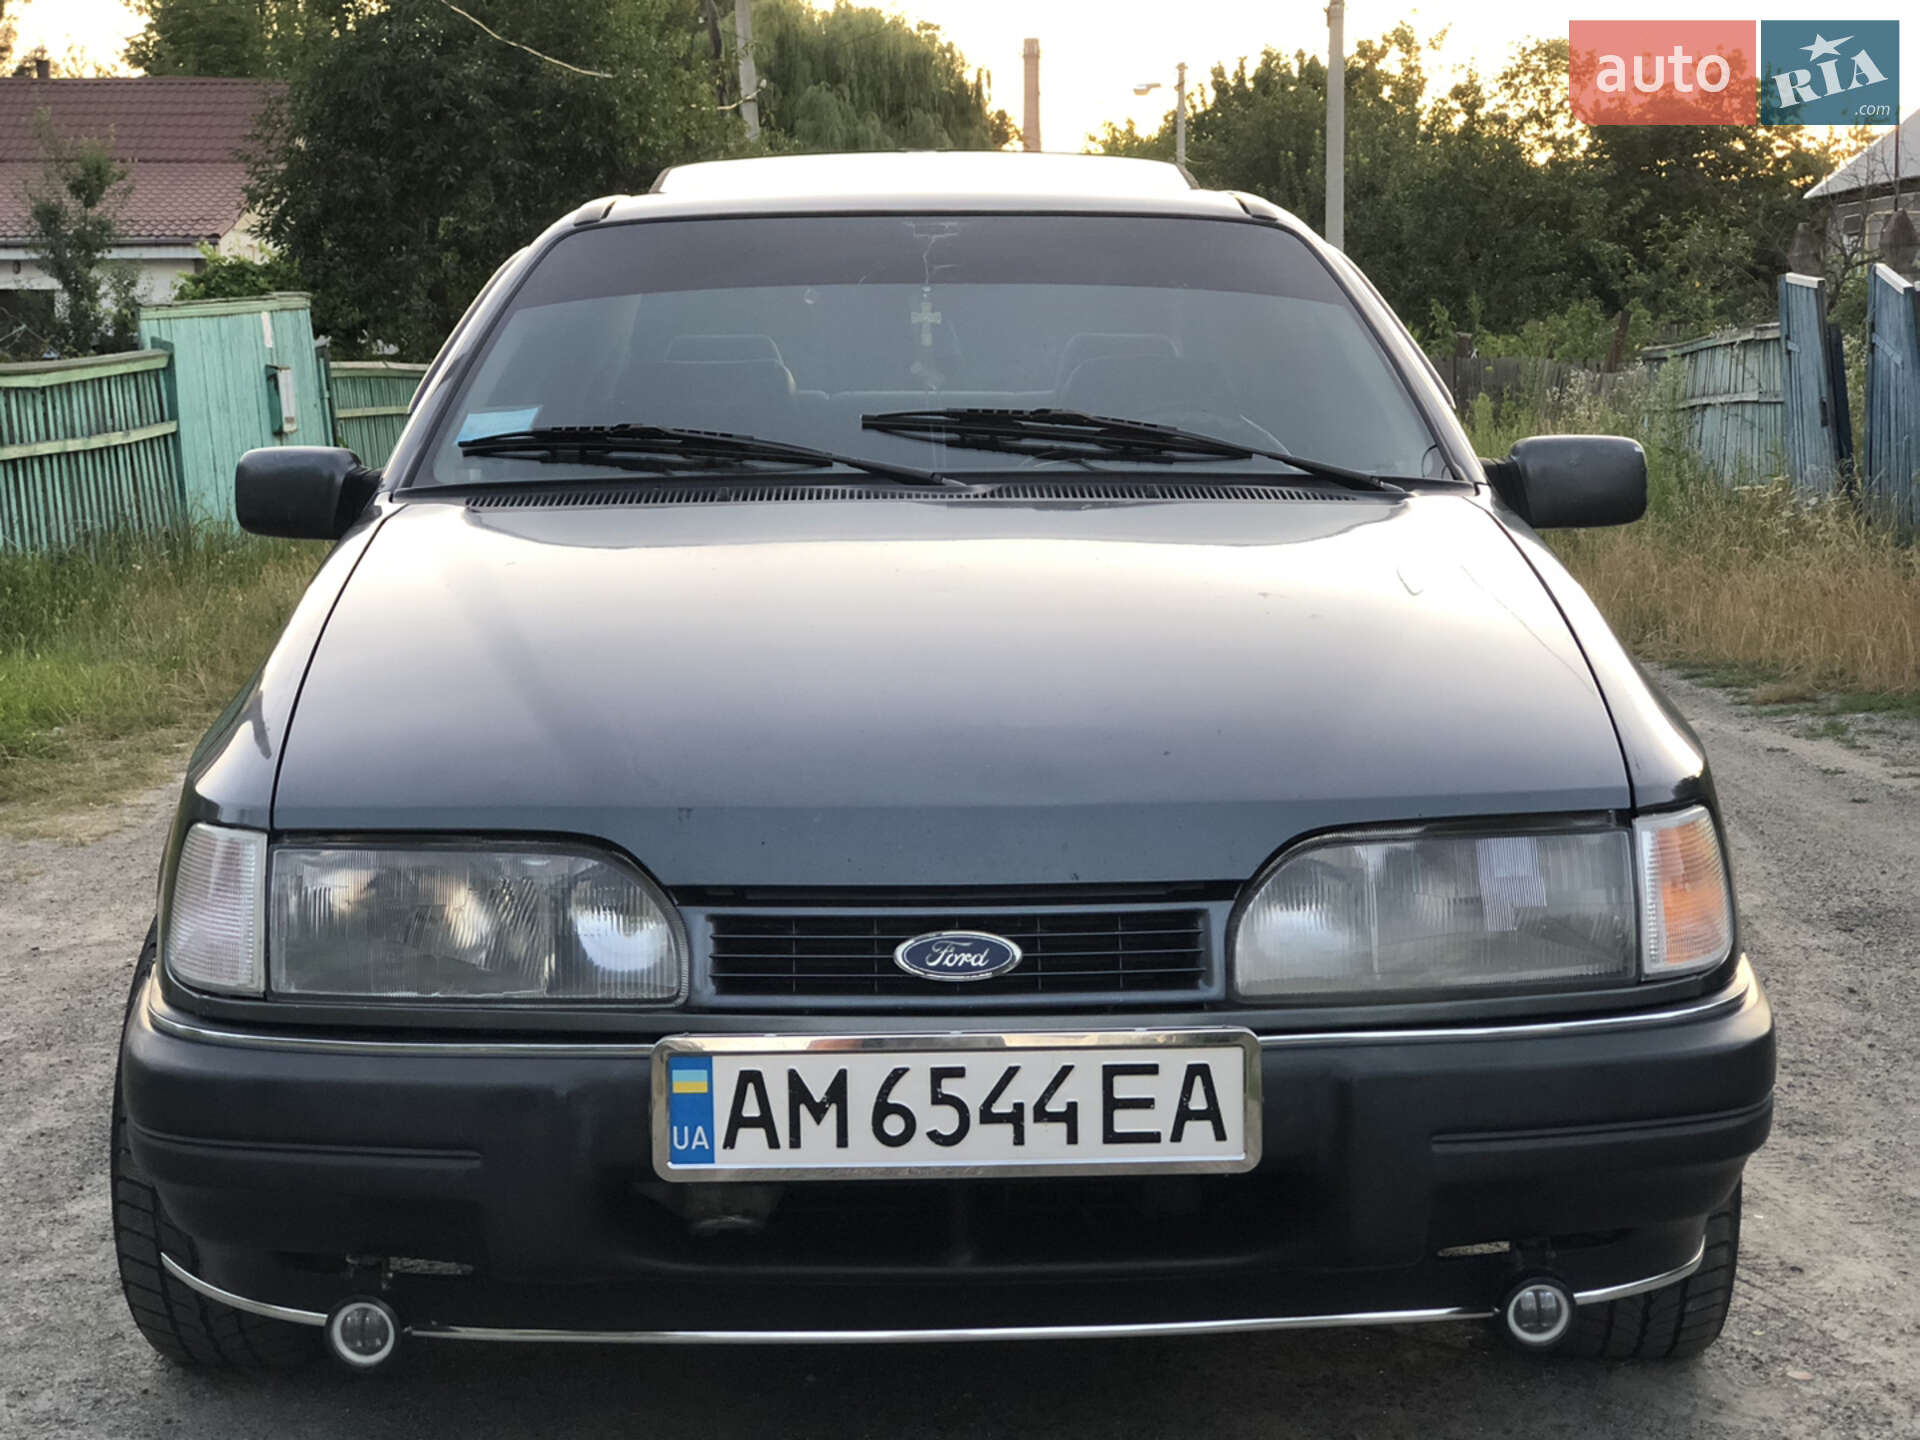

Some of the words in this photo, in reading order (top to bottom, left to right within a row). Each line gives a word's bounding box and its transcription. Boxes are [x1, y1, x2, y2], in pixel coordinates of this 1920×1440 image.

[925, 940, 990, 967] Ford
[722, 1068, 848, 1150] AM
[871, 1064, 1079, 1148] 6544
[1102, 1063, 1228, 1143] EA
[672, 1125, 710, 1151] UA
